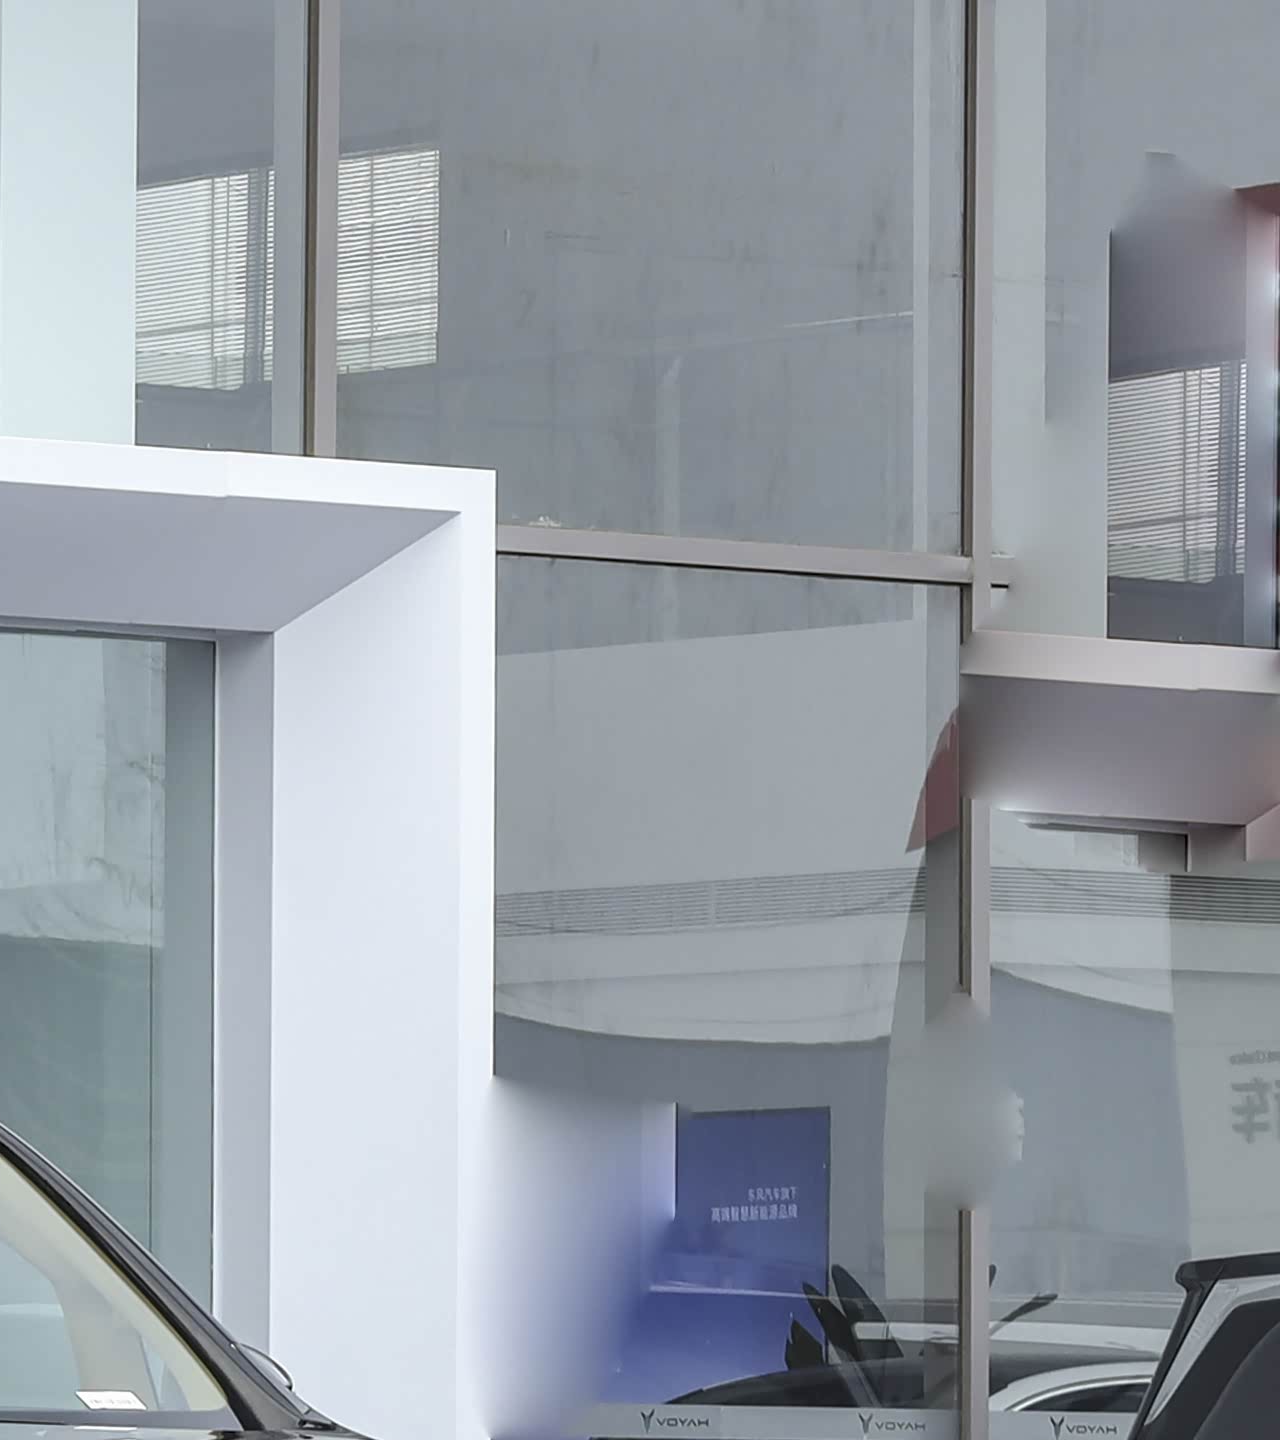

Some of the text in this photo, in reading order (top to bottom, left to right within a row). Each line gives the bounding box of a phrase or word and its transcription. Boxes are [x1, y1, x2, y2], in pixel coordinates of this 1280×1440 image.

[656, 1417, 710, 1427] VOYAH
[875, 1421, 926, 1431] VOYAH
[1066, 1425, 1118, 1435] VOYAH
